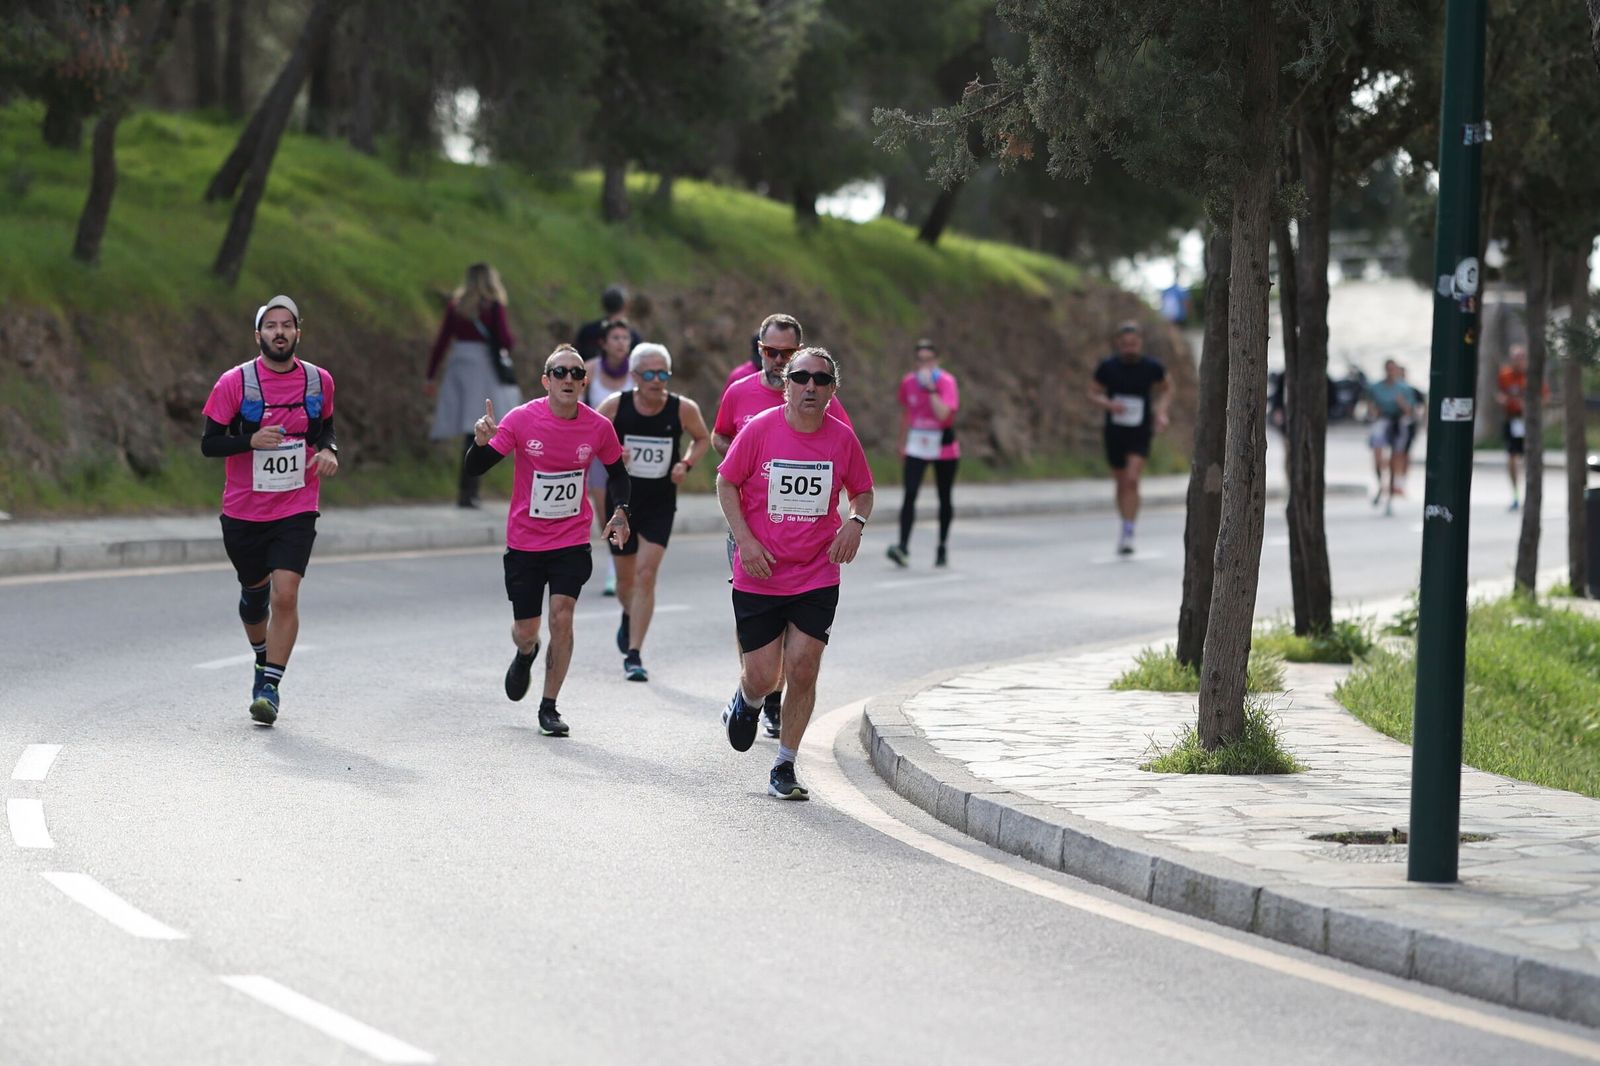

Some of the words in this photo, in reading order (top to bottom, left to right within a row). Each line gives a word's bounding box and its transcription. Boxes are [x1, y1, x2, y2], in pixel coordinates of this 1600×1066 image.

[262, 455, 299, 475] 401
[632, 447, 664, 464] 703
[542, 483, 577, 502] 720
[779, 475, 822, 496] 505
